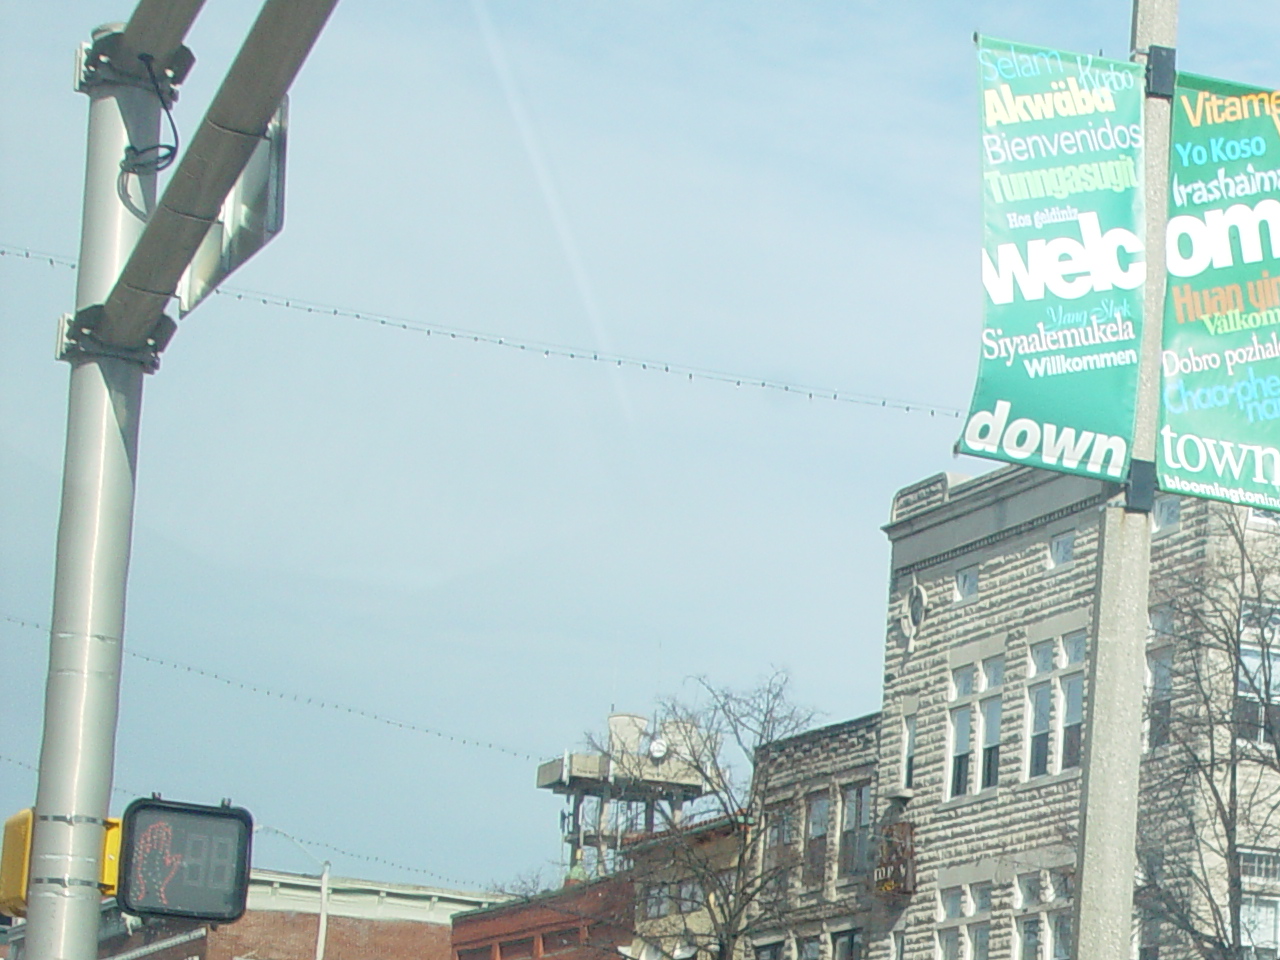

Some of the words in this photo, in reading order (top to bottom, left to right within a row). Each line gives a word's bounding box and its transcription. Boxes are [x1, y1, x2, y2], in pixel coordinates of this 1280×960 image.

[978, 46, 1064, 81] Selam
[984, 76, 1116, 127] Akwäba
[983, 117, 1142, 165] Bienvenidos
[1175, 141, 1207, 167] Yo
[1212, 135, 1266, 161] Koso
[1006, 211, 1032, 229] Hos
[981, 211, 1146, 306] welc
[1172, 282, 1245, 325] Huan
[982, 311, 1136, 367] Siyaalemukela
[1023, 348, 1138, 379] Willkommen
[1162, 347, 1221, 378] Dobro
[964, 400, 1127, 477] down
